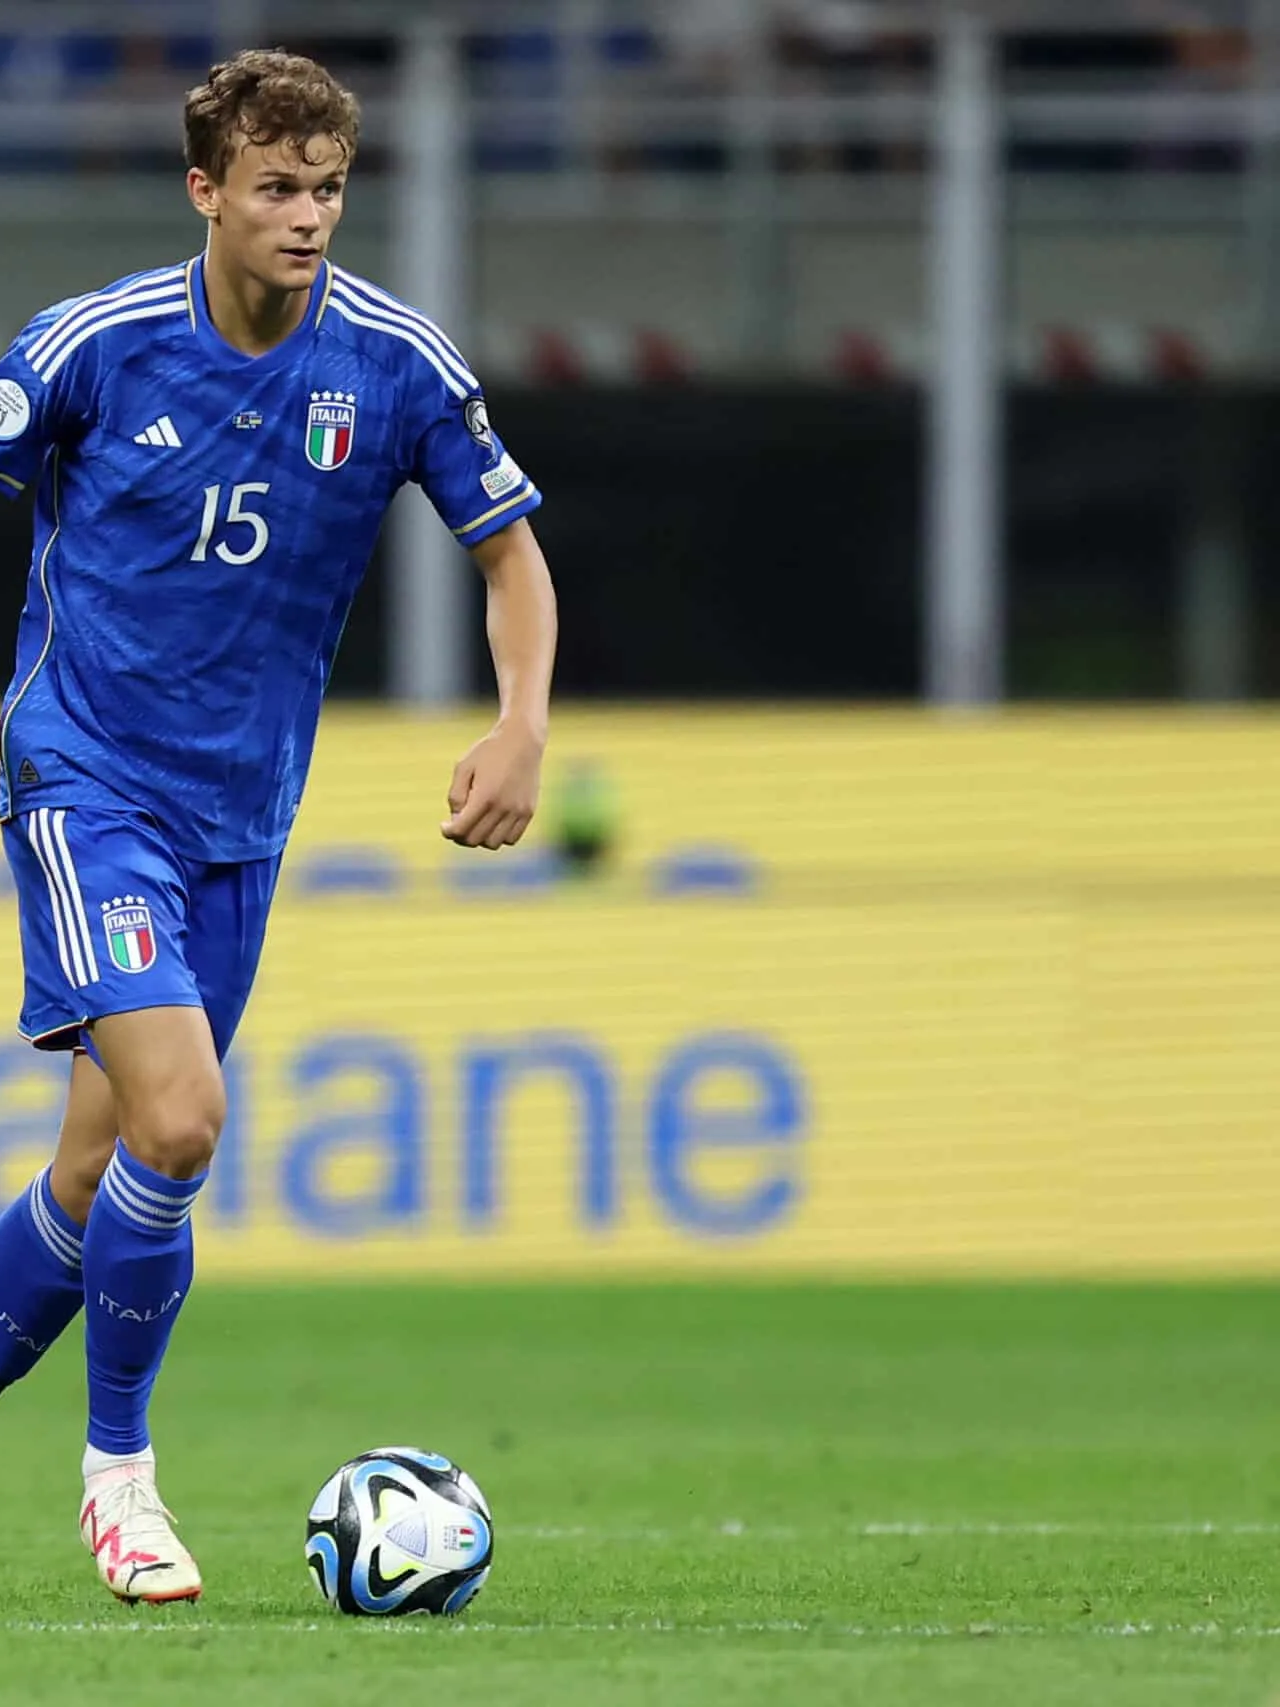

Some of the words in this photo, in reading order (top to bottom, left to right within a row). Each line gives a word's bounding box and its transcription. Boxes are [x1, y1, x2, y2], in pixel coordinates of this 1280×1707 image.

[312, 407, 350, 422] ITALIA
[190, 482, 270, 565] 15
[108, 911, 147, 929] ITALIA
